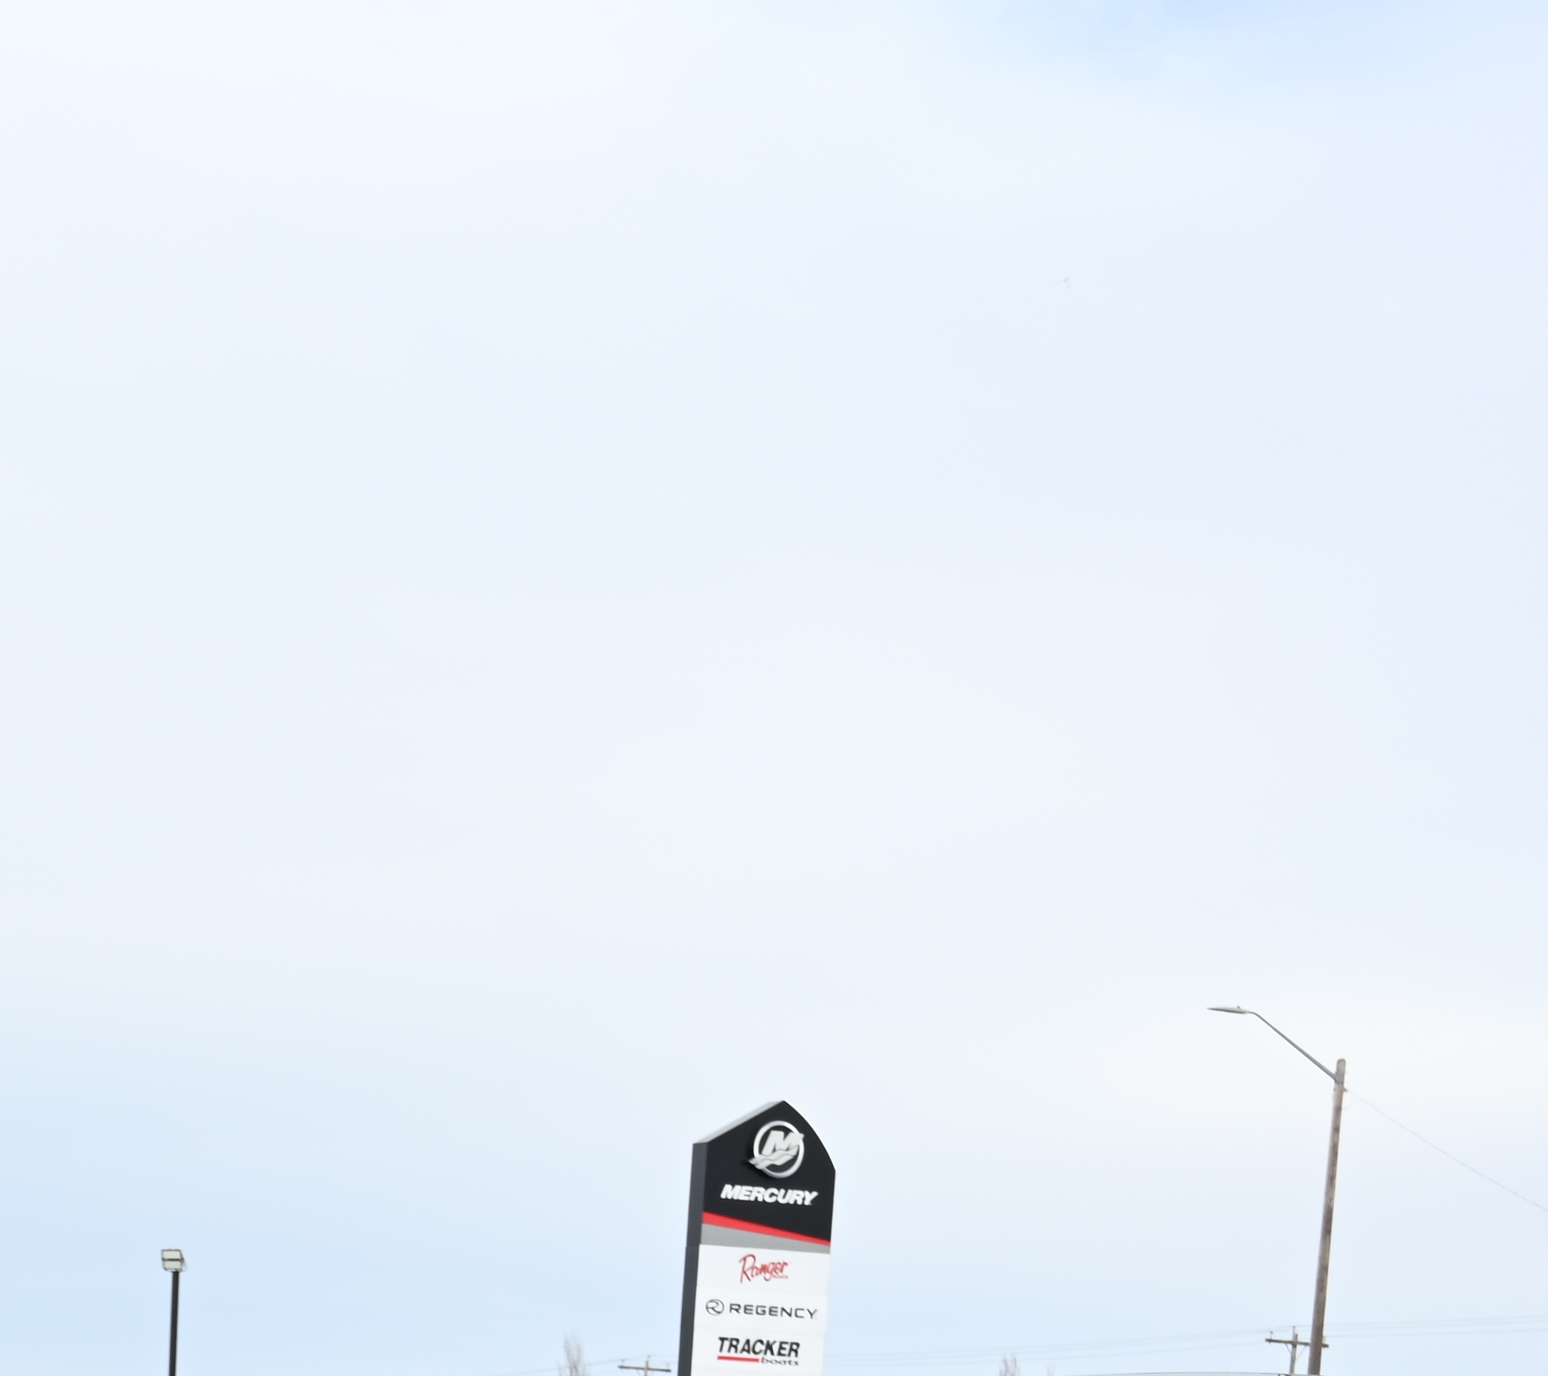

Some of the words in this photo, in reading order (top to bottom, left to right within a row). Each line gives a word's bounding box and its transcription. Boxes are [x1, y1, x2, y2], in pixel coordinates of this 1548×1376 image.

[720, 1184, 818, 1206] MERCURY
[738, 1254, 789, 1283] Ranger
[729, 1303, 818, 1320] REGENCY
[718, 1337, 800, 1358] TRACKER
